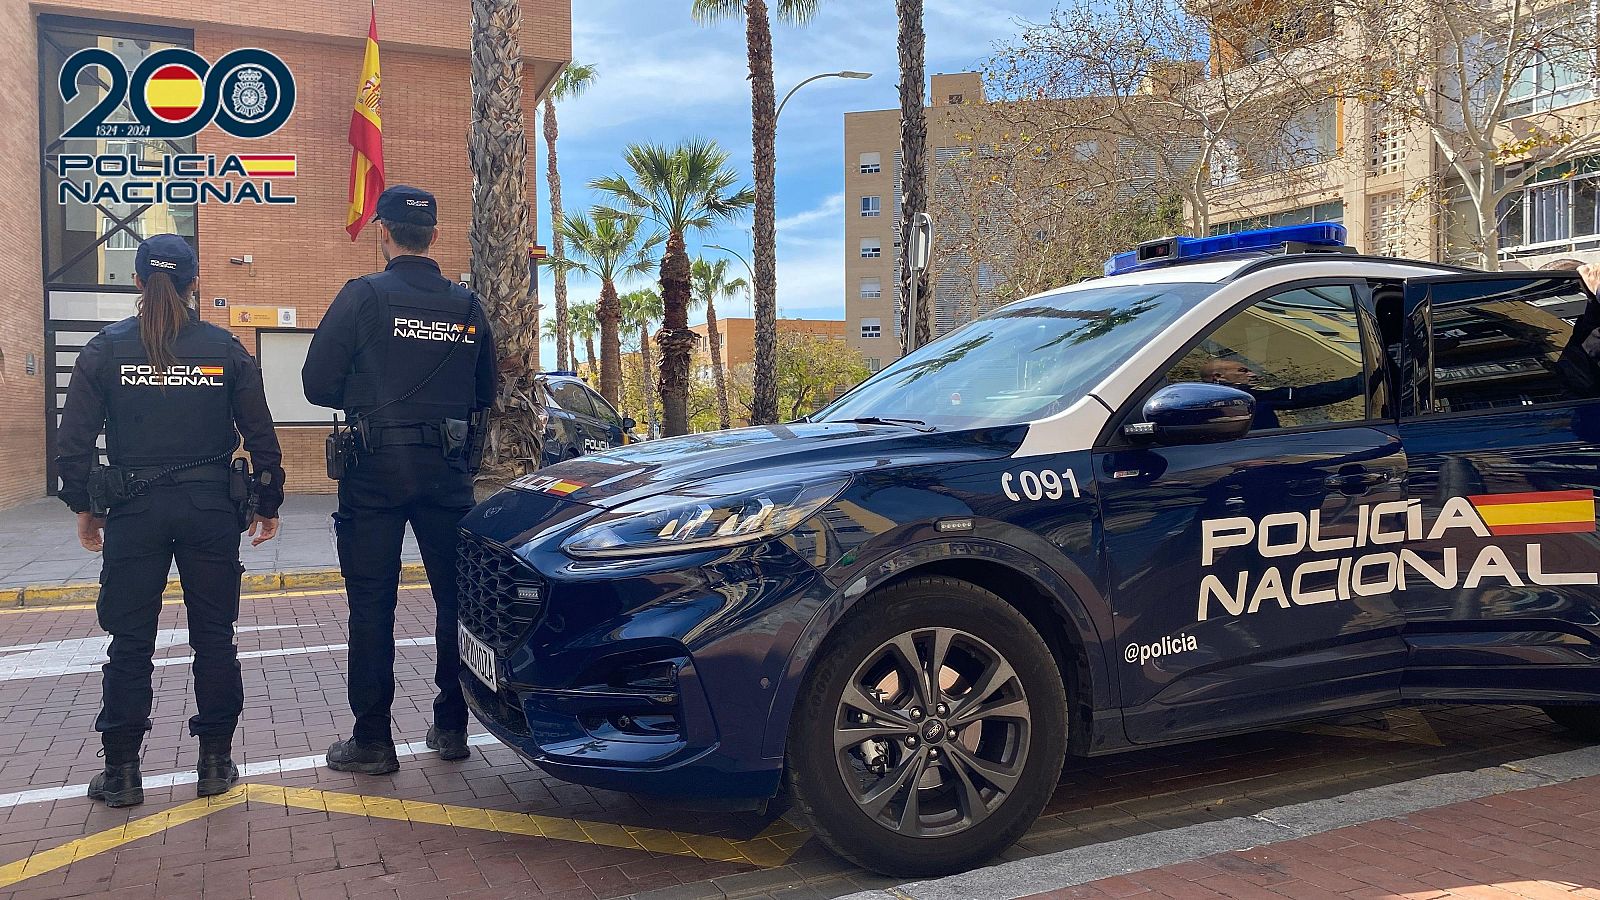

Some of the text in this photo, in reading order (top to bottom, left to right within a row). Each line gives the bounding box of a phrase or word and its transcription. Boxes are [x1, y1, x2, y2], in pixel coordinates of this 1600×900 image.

[393, 327, 475, 344] NACIONAL
[120, 375, 224, 386] NACIONAL
[1019, 468, 1081, 501] 091
[1198, 543, 1599, 621] NACIONAL
[1124, 632, 1198, 665] @policia
